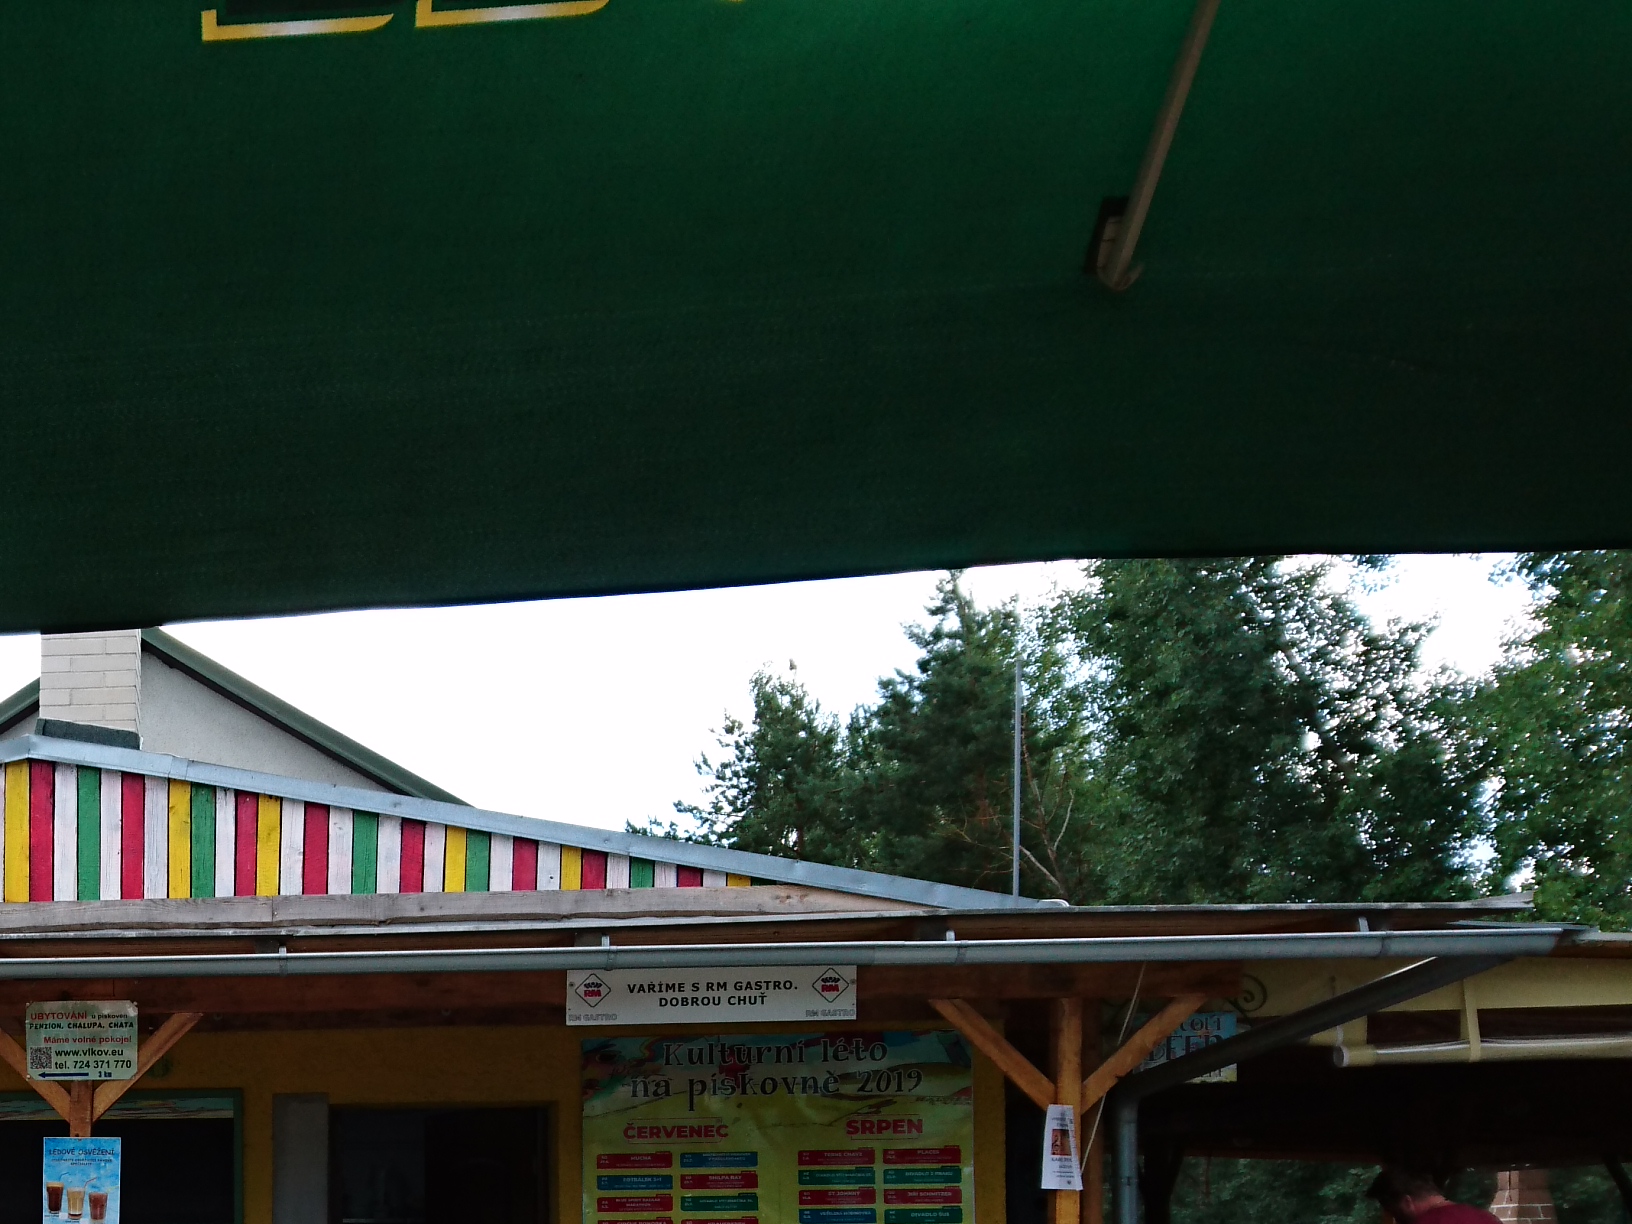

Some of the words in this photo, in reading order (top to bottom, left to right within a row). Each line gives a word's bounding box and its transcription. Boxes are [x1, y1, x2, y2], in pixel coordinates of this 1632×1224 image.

[627, 980, 685, 994] VAŘÍME
[691, 982, 700, 992] S
[706, 981, 727, 992] RM
[734, 979, 798, 991] GASTRO.
[821, 983, 840, 993] RM
[583, 989, 602, 998] RM
[658, 996, 721, 1008] DOBROU
[728, 994, 768, 1007] CHUŤ
[30, 1011, 87, 1021] UBYTOVÁNÍ
[583, 1013, 618, 1021] GASTRO
[820, 1008, 856, 1017] GASTRO
[108, 1021, 134, 1029] CHATA
[43, 1036, 70, 1044] Máme
[54, 1047, 124, 1057] www.vlkov.eu
[664, 1040, 804, 1065] Kulturní
[822, 1038, 888, 1062] léto
[54, 1060, 70, 1069] tel.
[73, 1060, 90, 1069] 724
[93, 1060, 110, 1069] 371
[114, 1059, 132, 1069] 770
[630, 1077, 671, 1098] na
[688, 1072, 841, 1112] pískovně
[857, 1069, 923, 1093] 2019
[623, 1122, 729, 1140] ČERVENEC
[846, 1118, 923, 1135] SRPEN
[49, 1147, 75, 1156] LEDOVÉ
